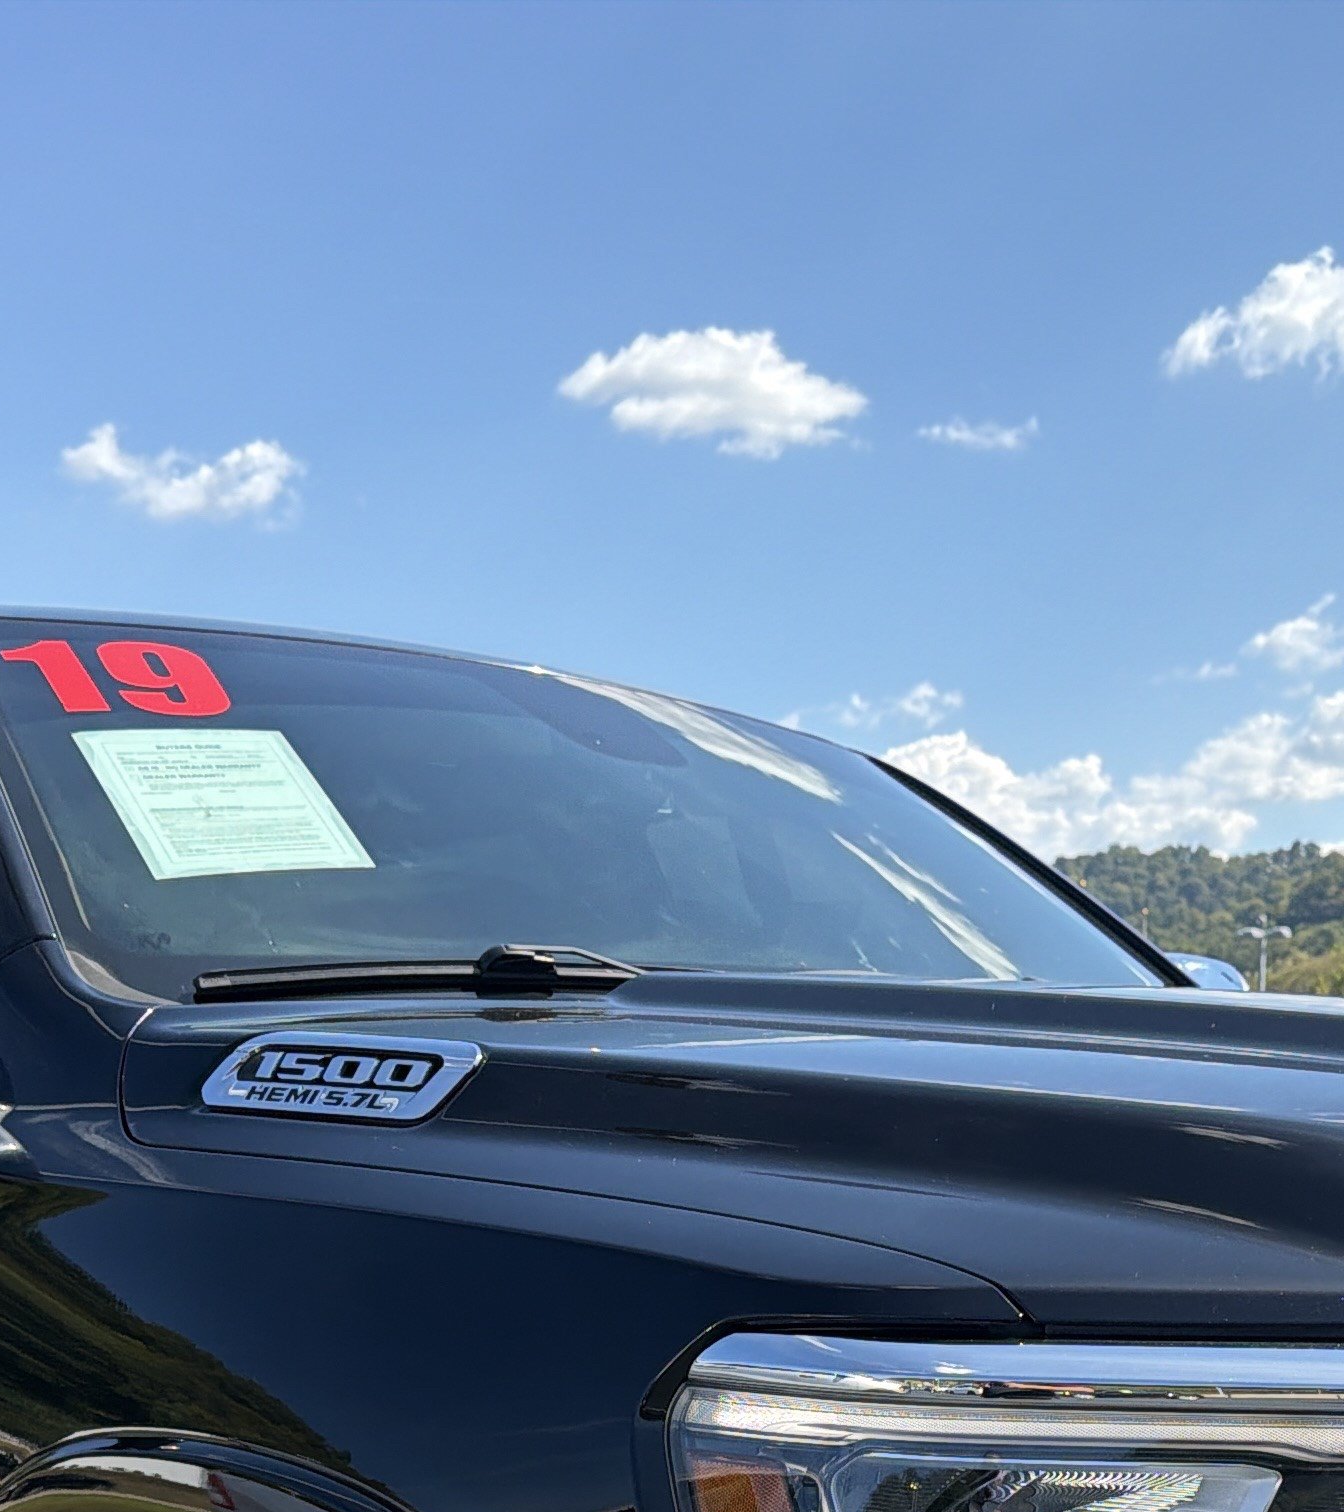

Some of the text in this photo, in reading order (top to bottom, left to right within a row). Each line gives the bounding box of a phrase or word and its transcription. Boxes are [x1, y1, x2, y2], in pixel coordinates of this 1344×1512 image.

[0, 640, 231, 716] 19
[255, 1051, 433, 1088] 1500
[244, 1085, 387, 1110] HEMI 5.7L
